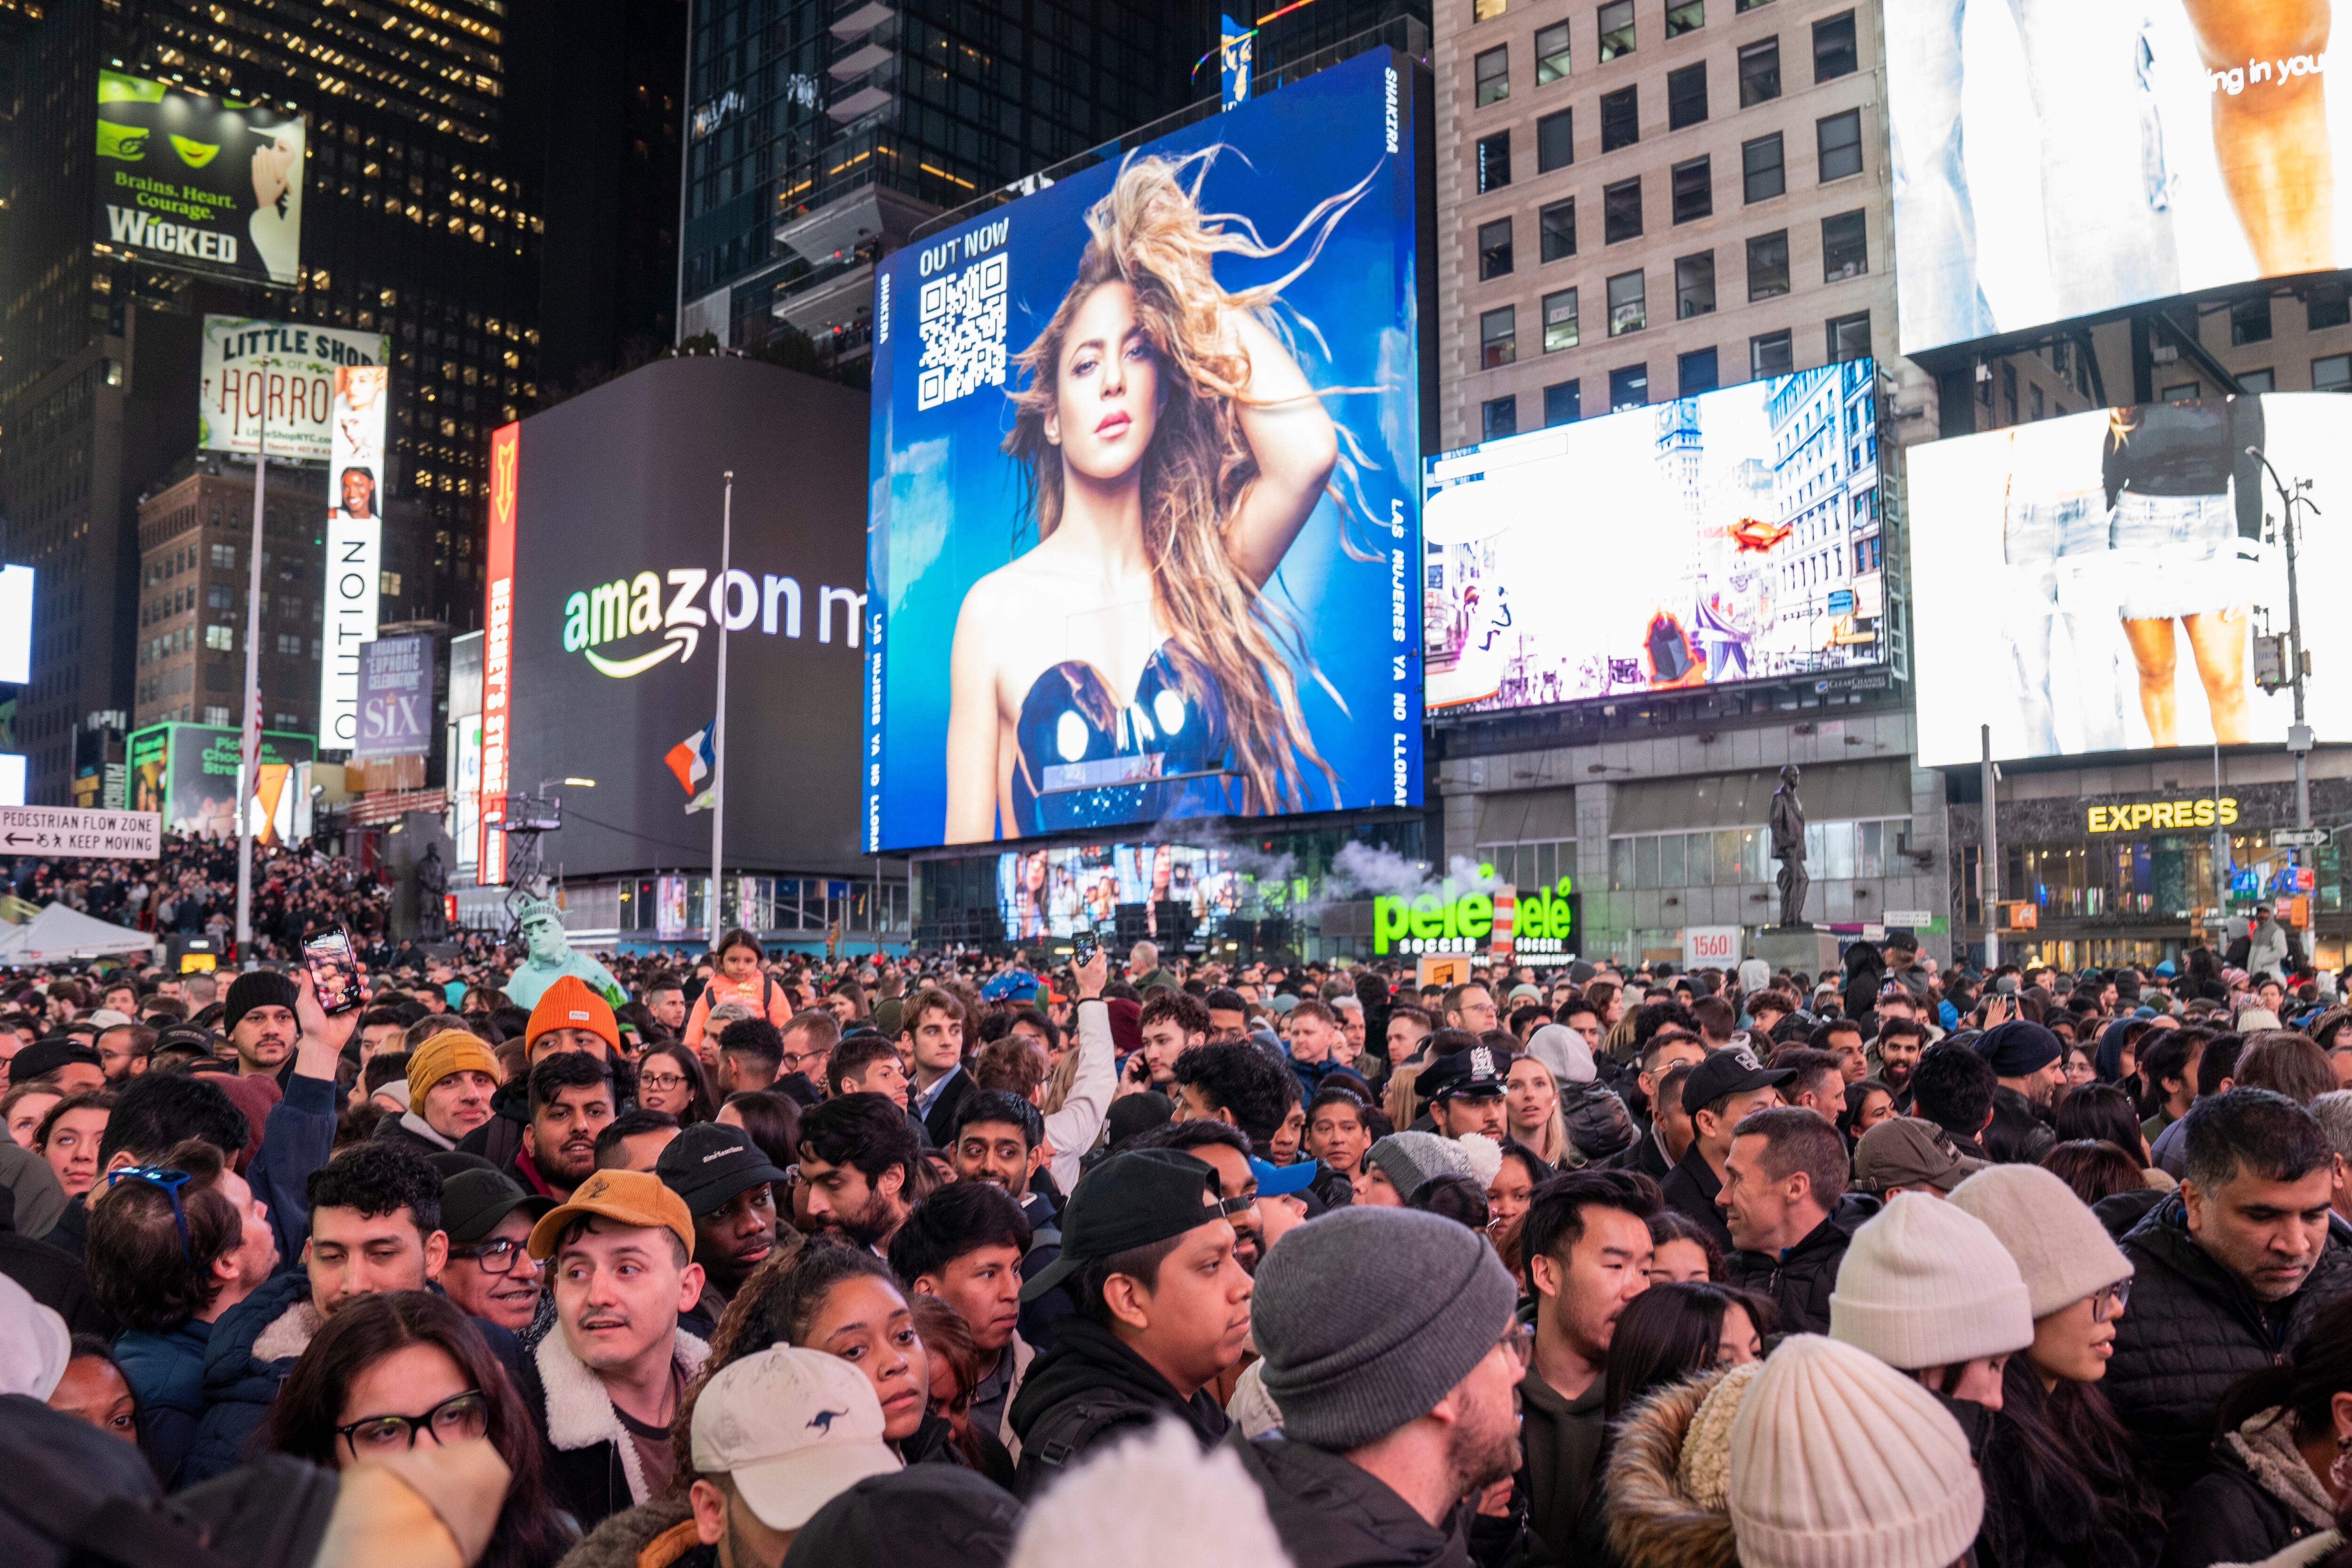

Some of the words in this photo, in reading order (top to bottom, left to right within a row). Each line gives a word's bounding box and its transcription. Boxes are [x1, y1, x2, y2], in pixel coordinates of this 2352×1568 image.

[2249, 57, 2272, 84] in
[1384, 67, 1398, 153] SHAKIRA
[115, 171, 179, 198] Brains.
[183, 185, 237, 209] Heart.
[136, 192, 215, 221] Courage.
[920, 238, 961, 277] OUT
[965, 217, 1009, 259] NOW
[880, 273, 890, 344] SHAKIRA
[223, 328, 309, 362] LITTLE
[221, 368, 328, 435] HORRO
[1391, 498, 1404, 539] LAS
[564, 568, 802, 653] amazon
[1392, 549, 1406, 643] MUJERES
[486, 578, 511, 709] HERSHEY'S
[873, 613, 882, 645] LAS
[1393, 654, 1406, 681] YA
[872, 652, 882, 726] MUJERES
[1393, 692, 1406, 721] NO
[483, 714, 505, 795] STORE
[871, 733, 880, 756] YA
[871, 763, 880, 787] NO
[3, 812, 79, 828] PEDESTRIAN
[83, 816, 117, 830] FLOW
[121, 818, 152, 832] ZONE
[2088, 798, 2238, 833] EXPRESS
[69, 835, 100, 849] KEEP
[105, 836, 152, 851] MOVING
[1399, 937, 1477, 954] SOCCER
[1515, 937, 1562, 953] SOCCER
[1692, 934, 1727, 956] 1560
